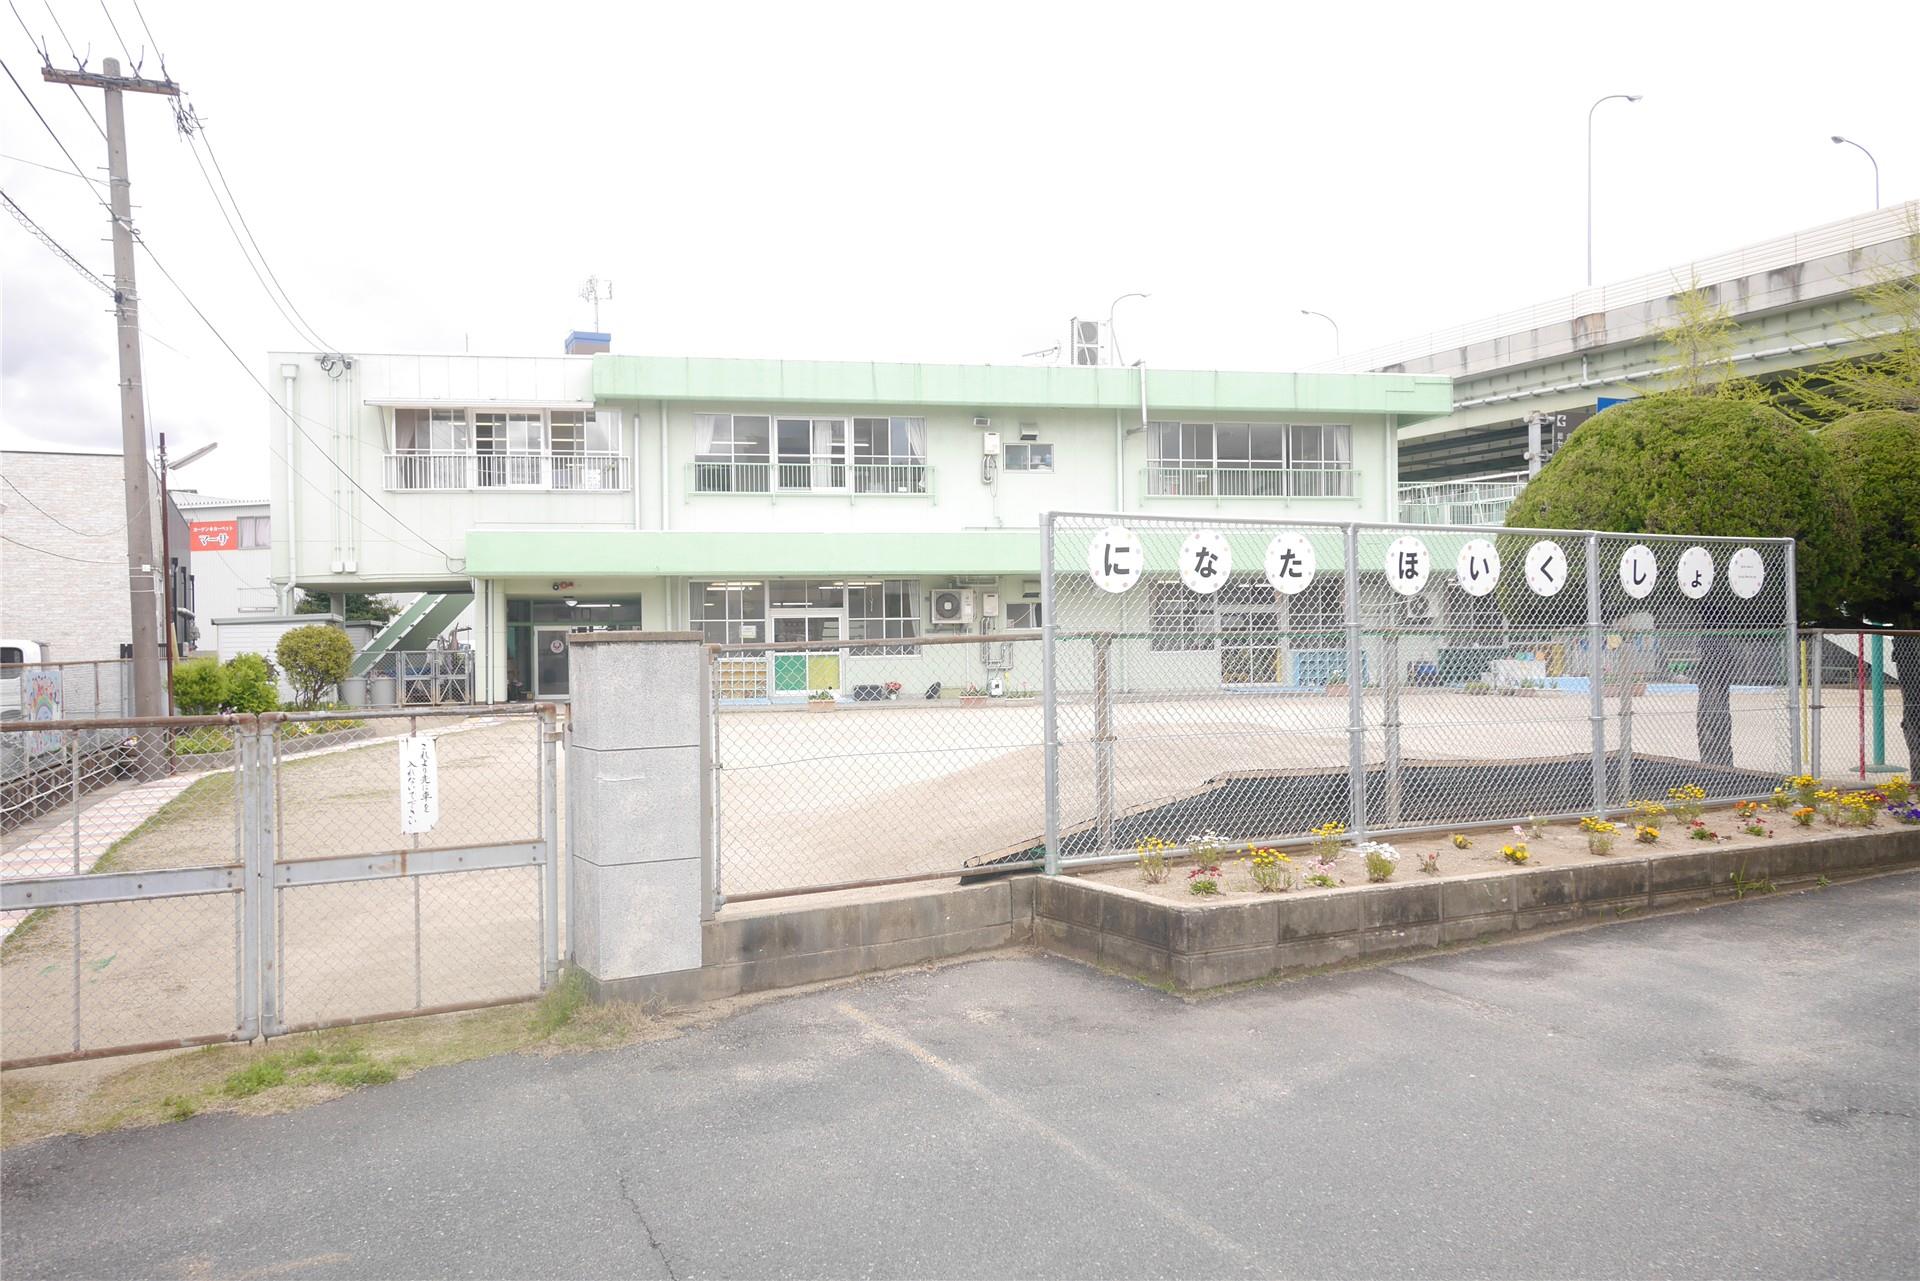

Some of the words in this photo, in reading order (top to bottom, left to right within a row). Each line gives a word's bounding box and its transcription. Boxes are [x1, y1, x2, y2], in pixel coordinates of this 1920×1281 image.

[420, 743, 432, 812] これより先に車を
